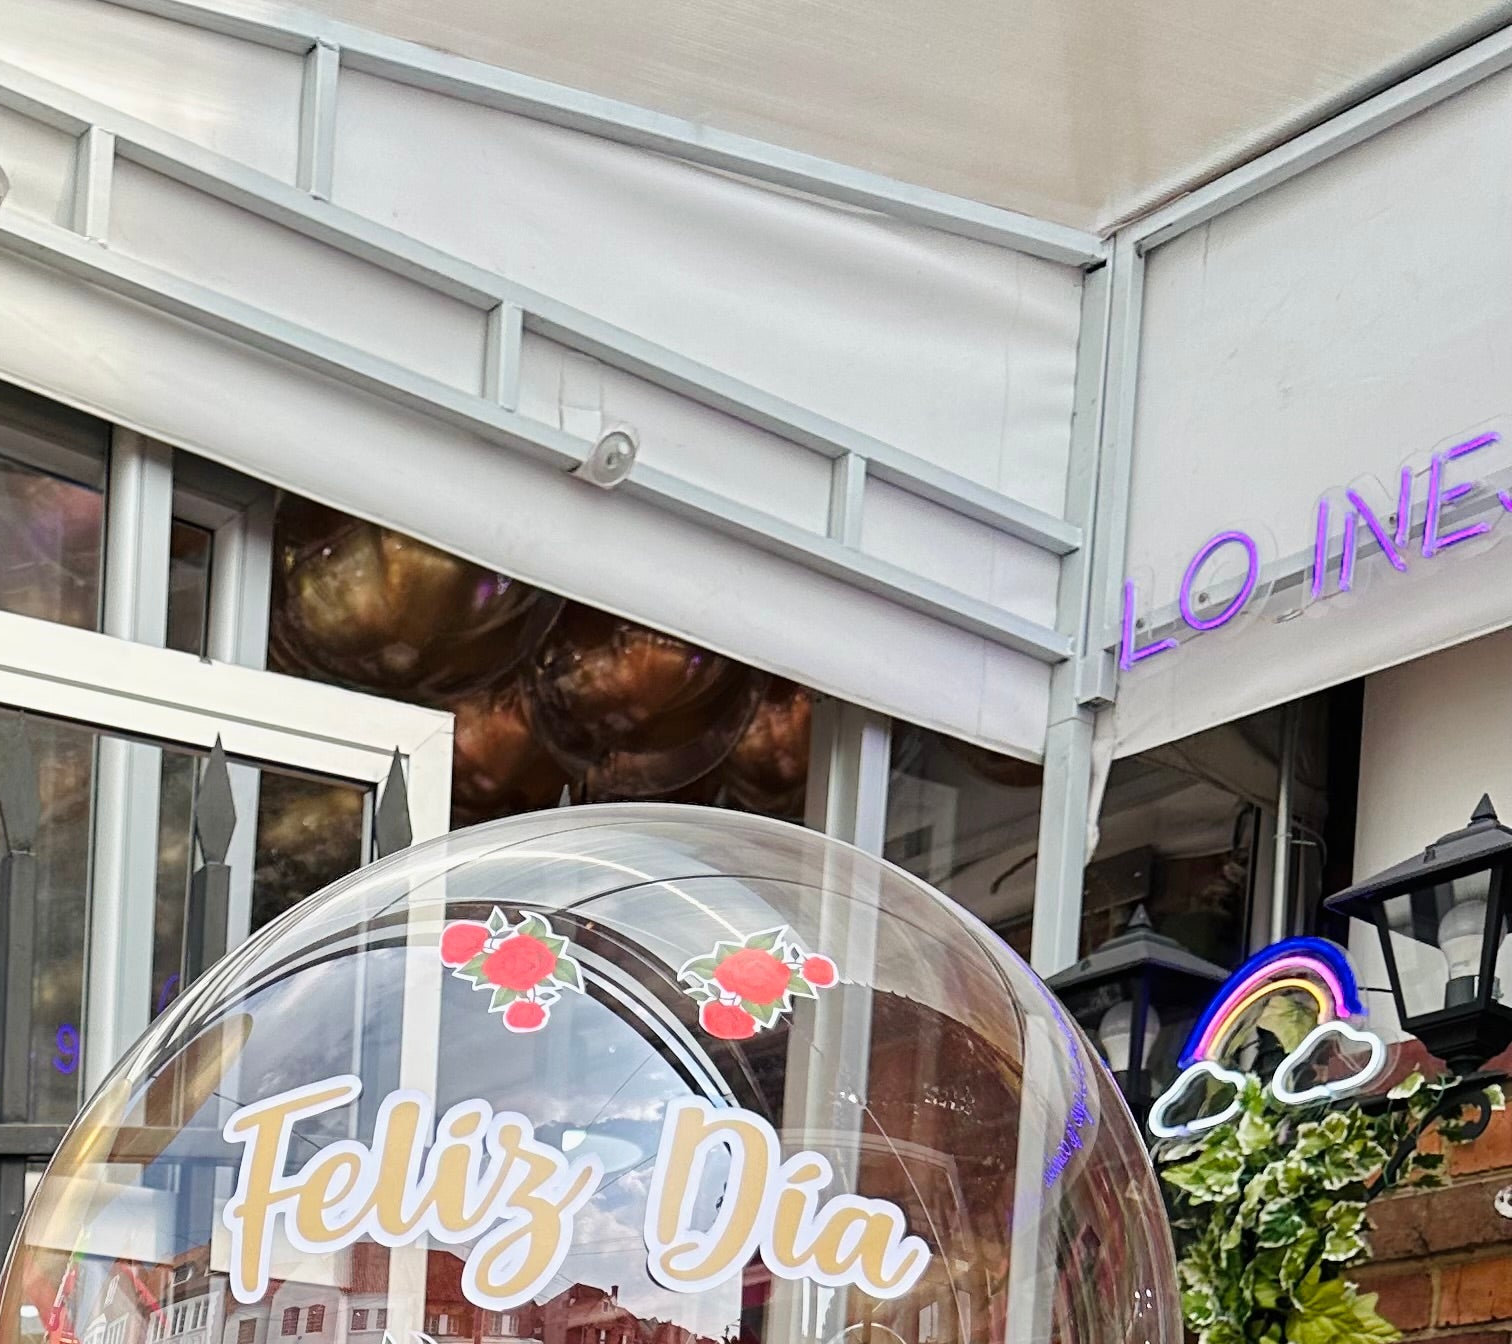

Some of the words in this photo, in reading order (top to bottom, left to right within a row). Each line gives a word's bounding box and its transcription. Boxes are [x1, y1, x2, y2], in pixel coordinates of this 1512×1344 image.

[1120, 530, 1259, 671] LO
[1311, 432, 1512, 600] INE
[226, 1078, 594, 1306] Feliz
[646, 1098, 929, 1296] Día
